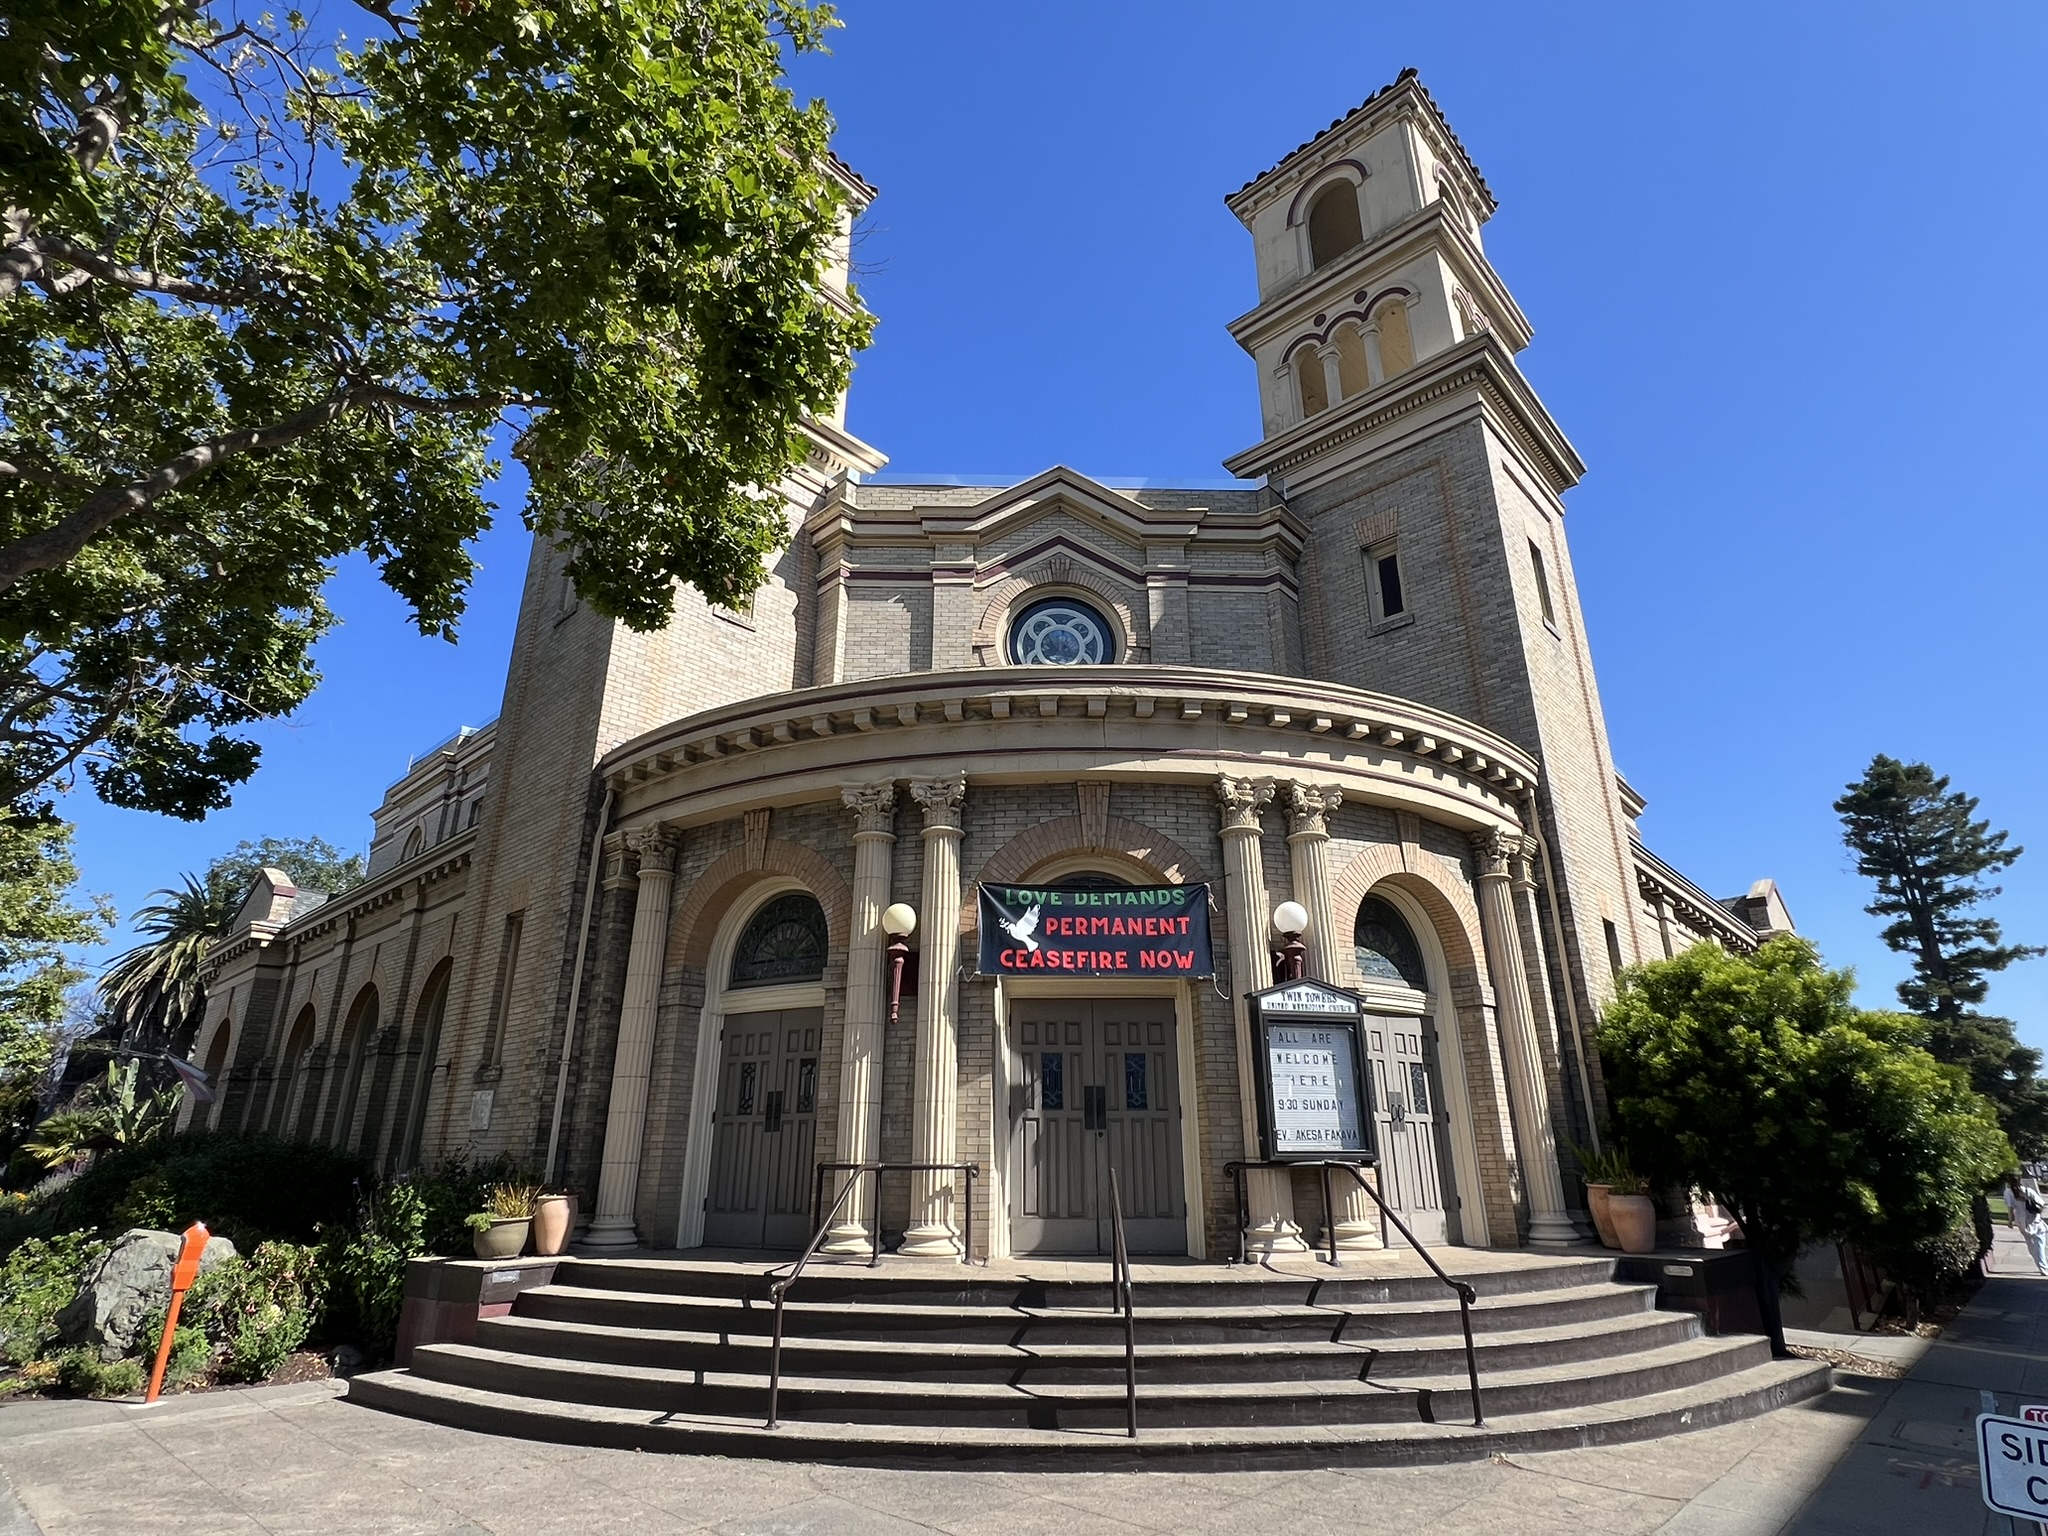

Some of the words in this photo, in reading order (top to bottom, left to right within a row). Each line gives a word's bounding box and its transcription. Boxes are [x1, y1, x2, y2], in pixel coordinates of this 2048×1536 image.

[1005, 888, 1063, 906] LOVE
[1074, 888, 1186, 906] DEMANDS
[1046, 916, 1190, 936] PERMANENT
[1000, 949, 1128, 969] CEASEFIRE
[1140, 950, 1195, 969] NOW
[1281, 991, 1302, 1002] TWIN
[1305, 992, 1338, 1003] TOWERS
[1292, 1003, 1325, 1011] METHODIST
[1328, 1004, 1352, 1012] CHURCH
[1278, 1032, 1299, 1043] ALL
[1311, 1033, 1332, 1044] ARE
[1277, 1053, 1338, 1065] WELCOME
[1303, 1099, 1344, 1111] SUNDAY
[1296, 1129, 1323, 1141] AKESA
[1325, 1130, 1359, 1141] FAKAVA
